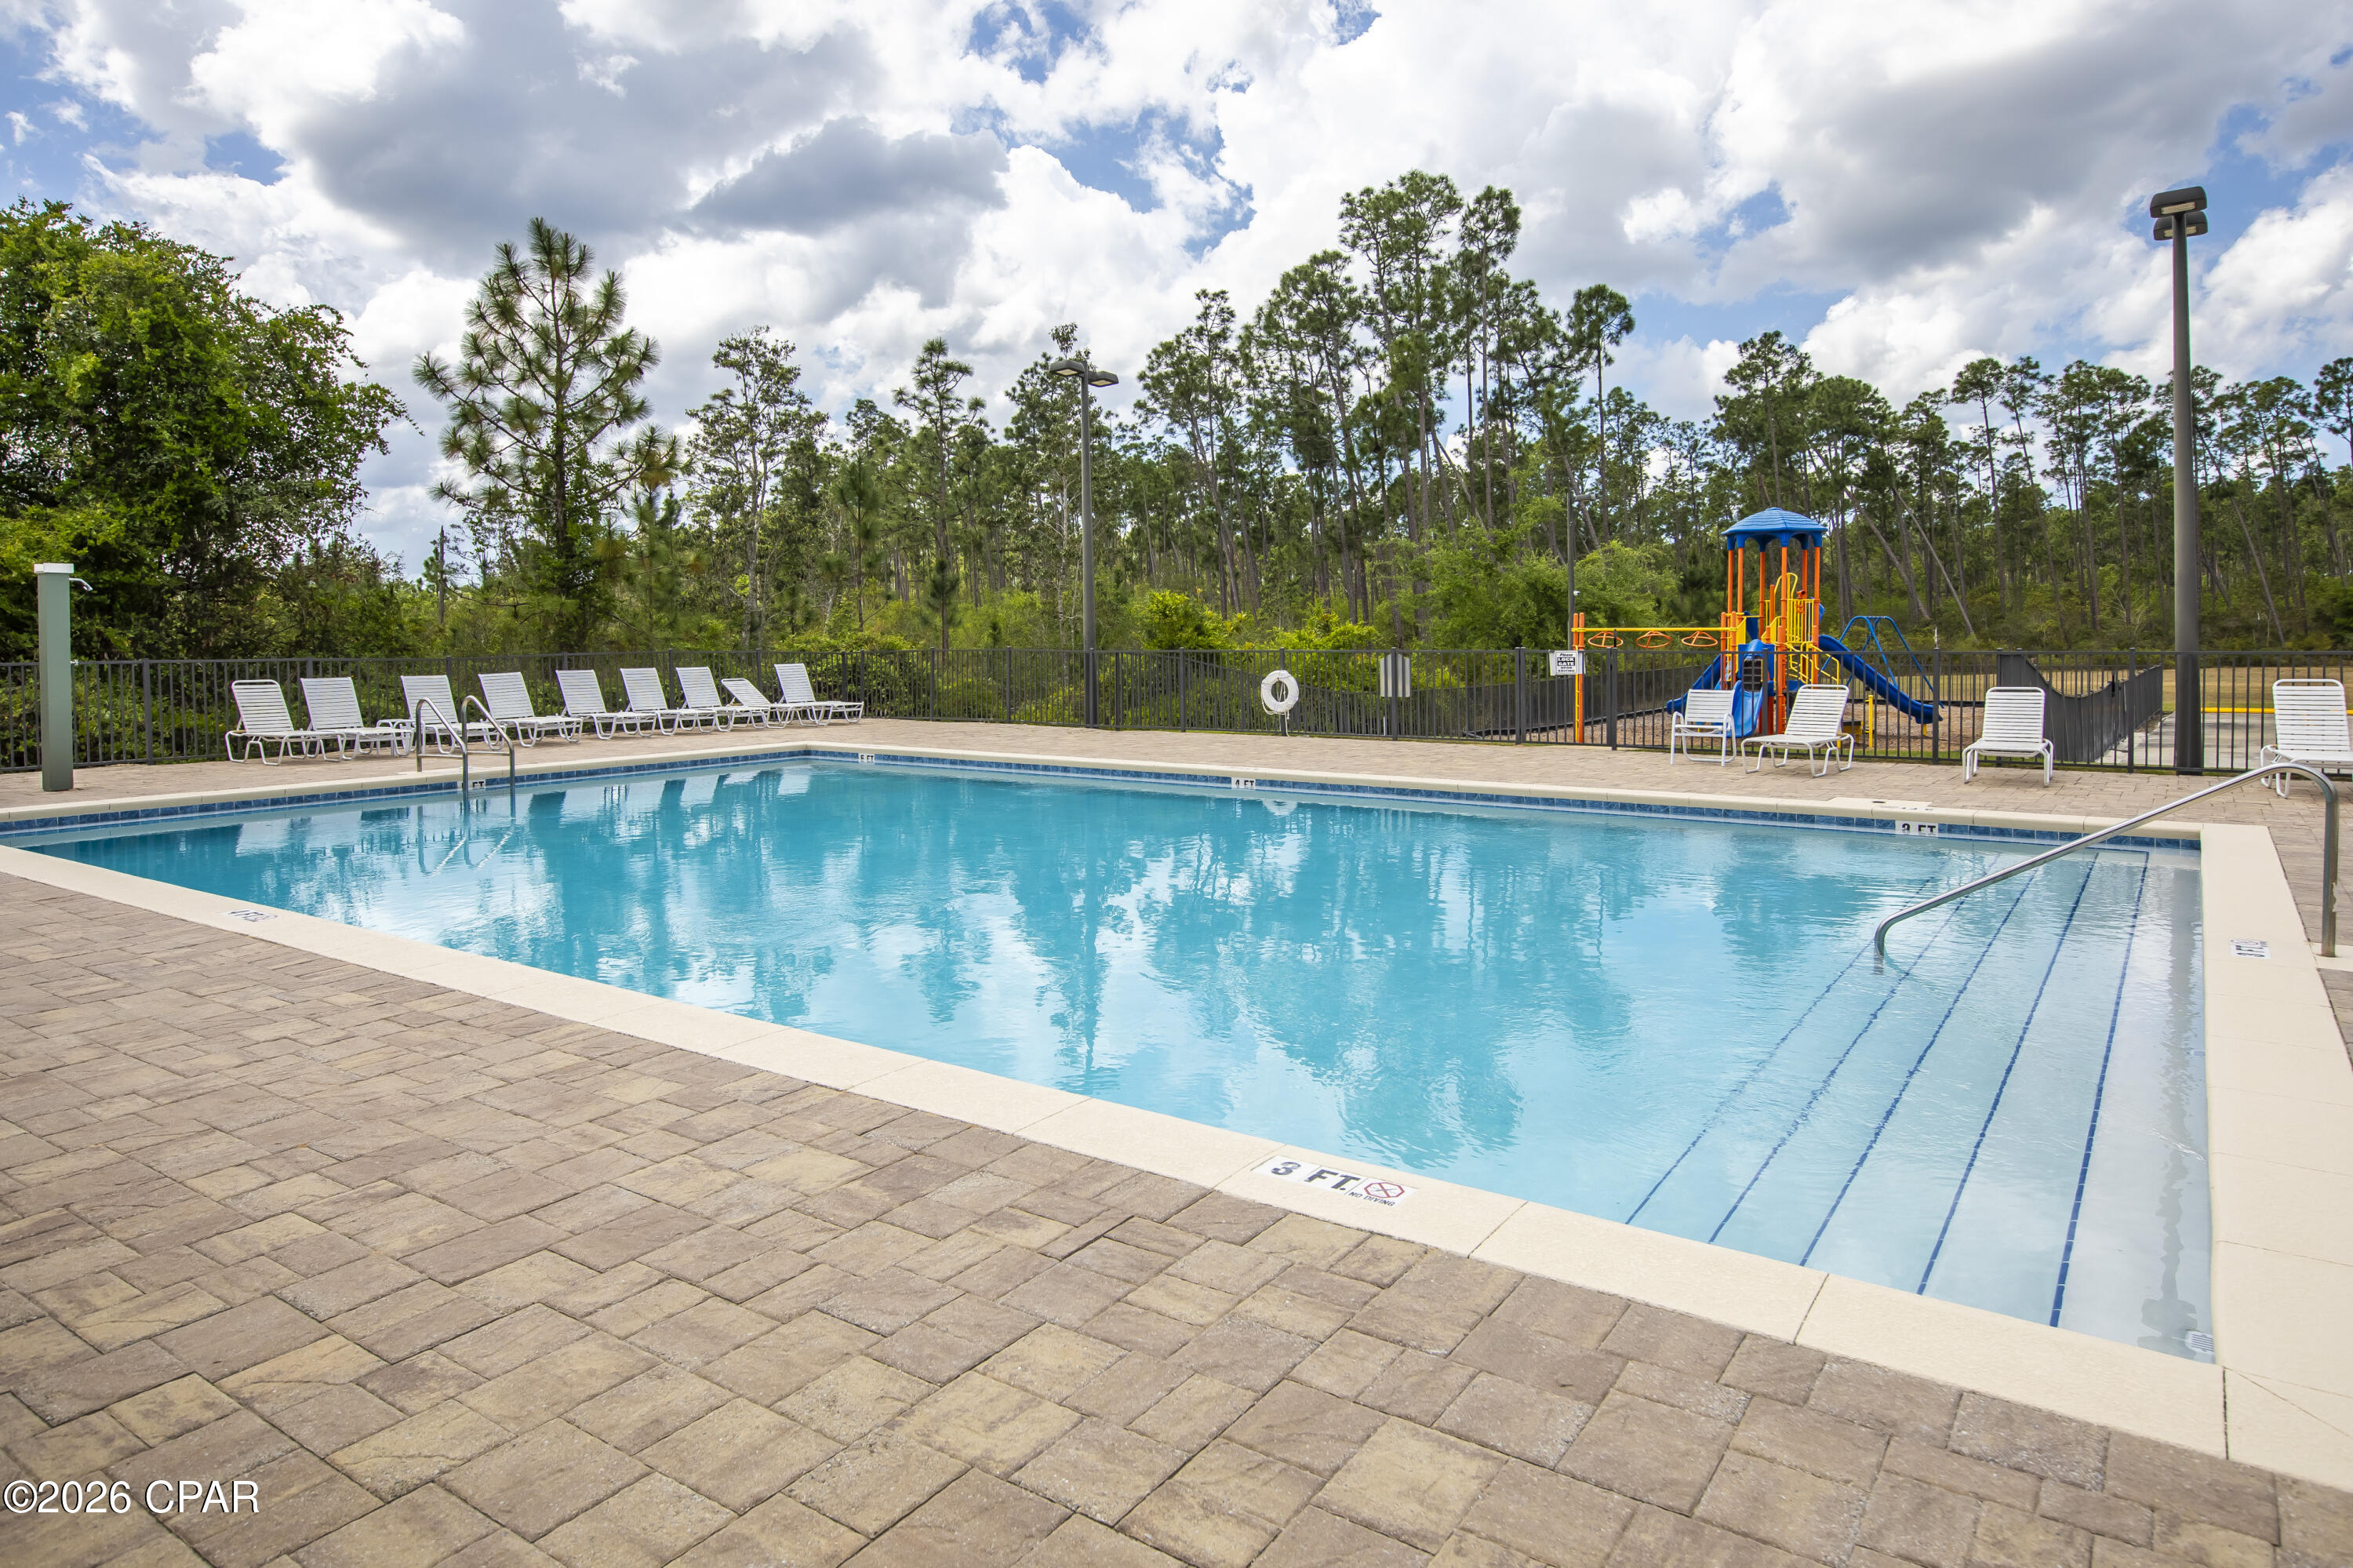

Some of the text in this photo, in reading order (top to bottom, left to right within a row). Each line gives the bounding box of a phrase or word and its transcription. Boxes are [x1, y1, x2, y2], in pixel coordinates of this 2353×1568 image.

[1271, 1161, 1361, 1191] 3 FT.
[1363, 1195, 1395, 1206] DIVING
